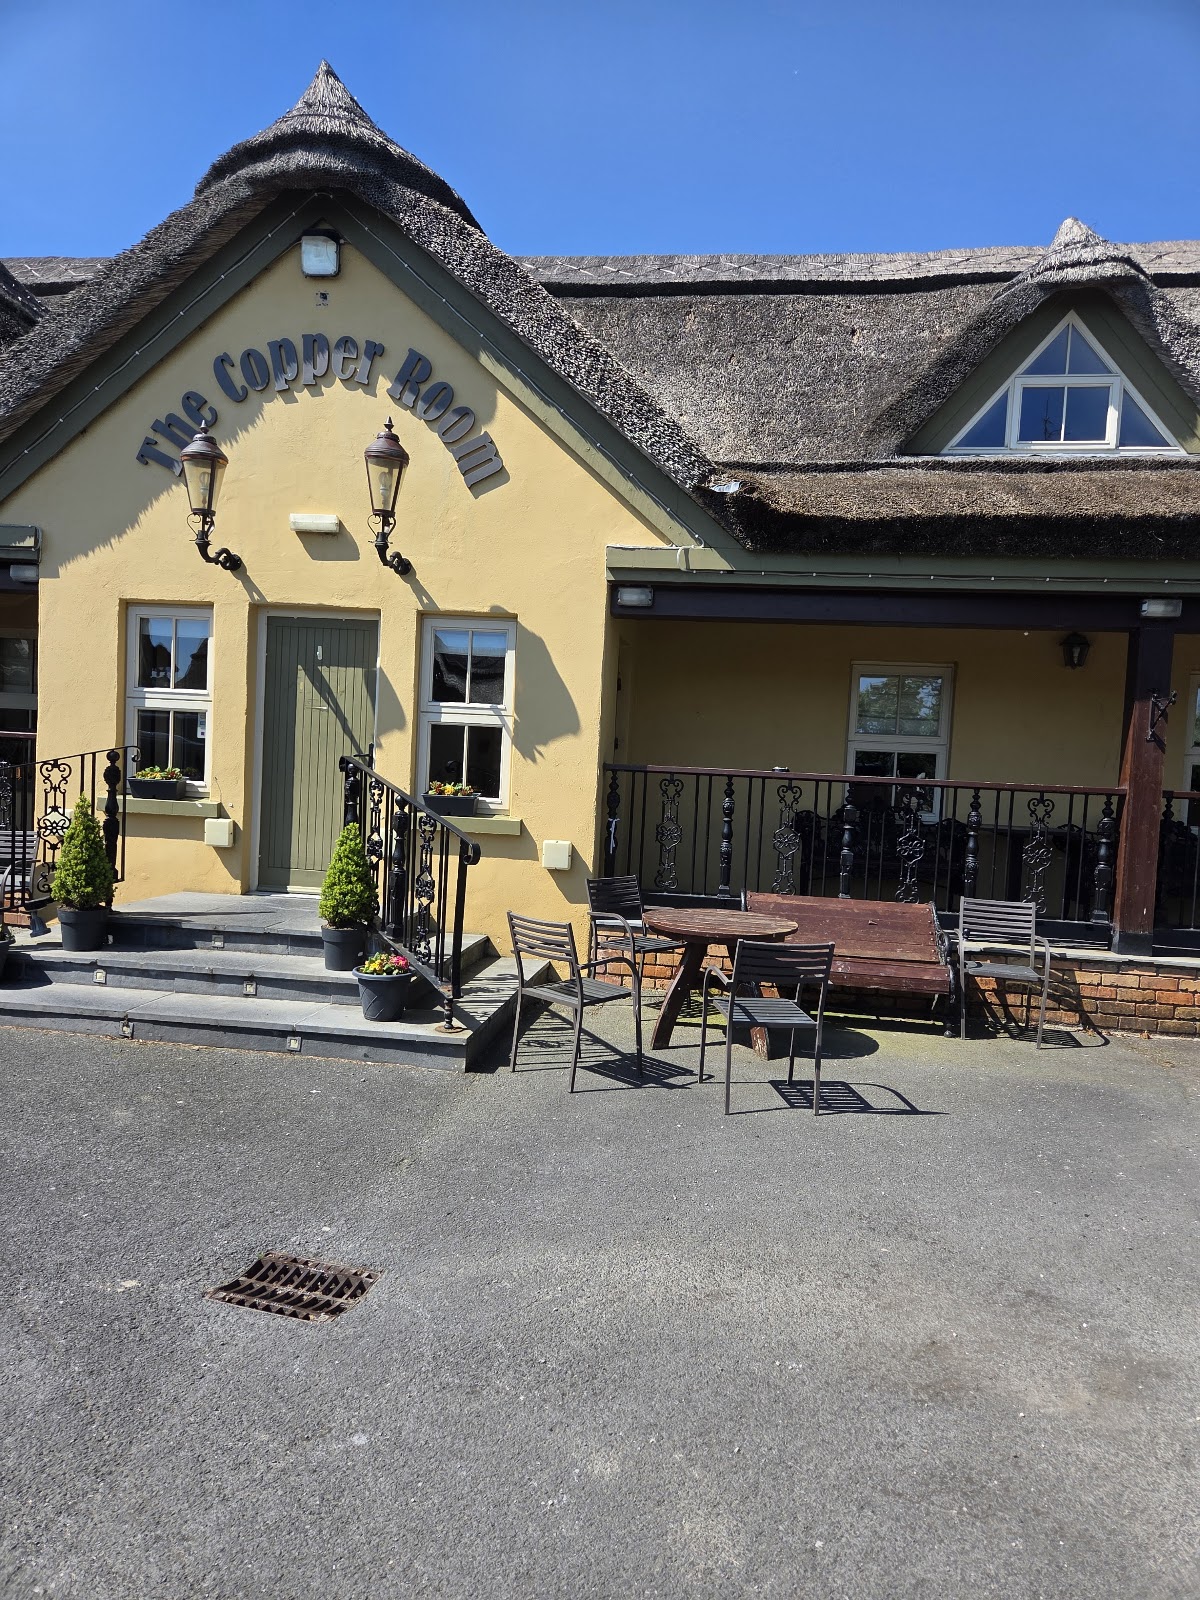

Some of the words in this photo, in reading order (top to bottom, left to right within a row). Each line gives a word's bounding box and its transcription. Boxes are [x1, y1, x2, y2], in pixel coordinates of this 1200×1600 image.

[136, 391, 218, 477] The
[213, 332, 385, 403] Copper
[387, 348, 503, 488] Room
